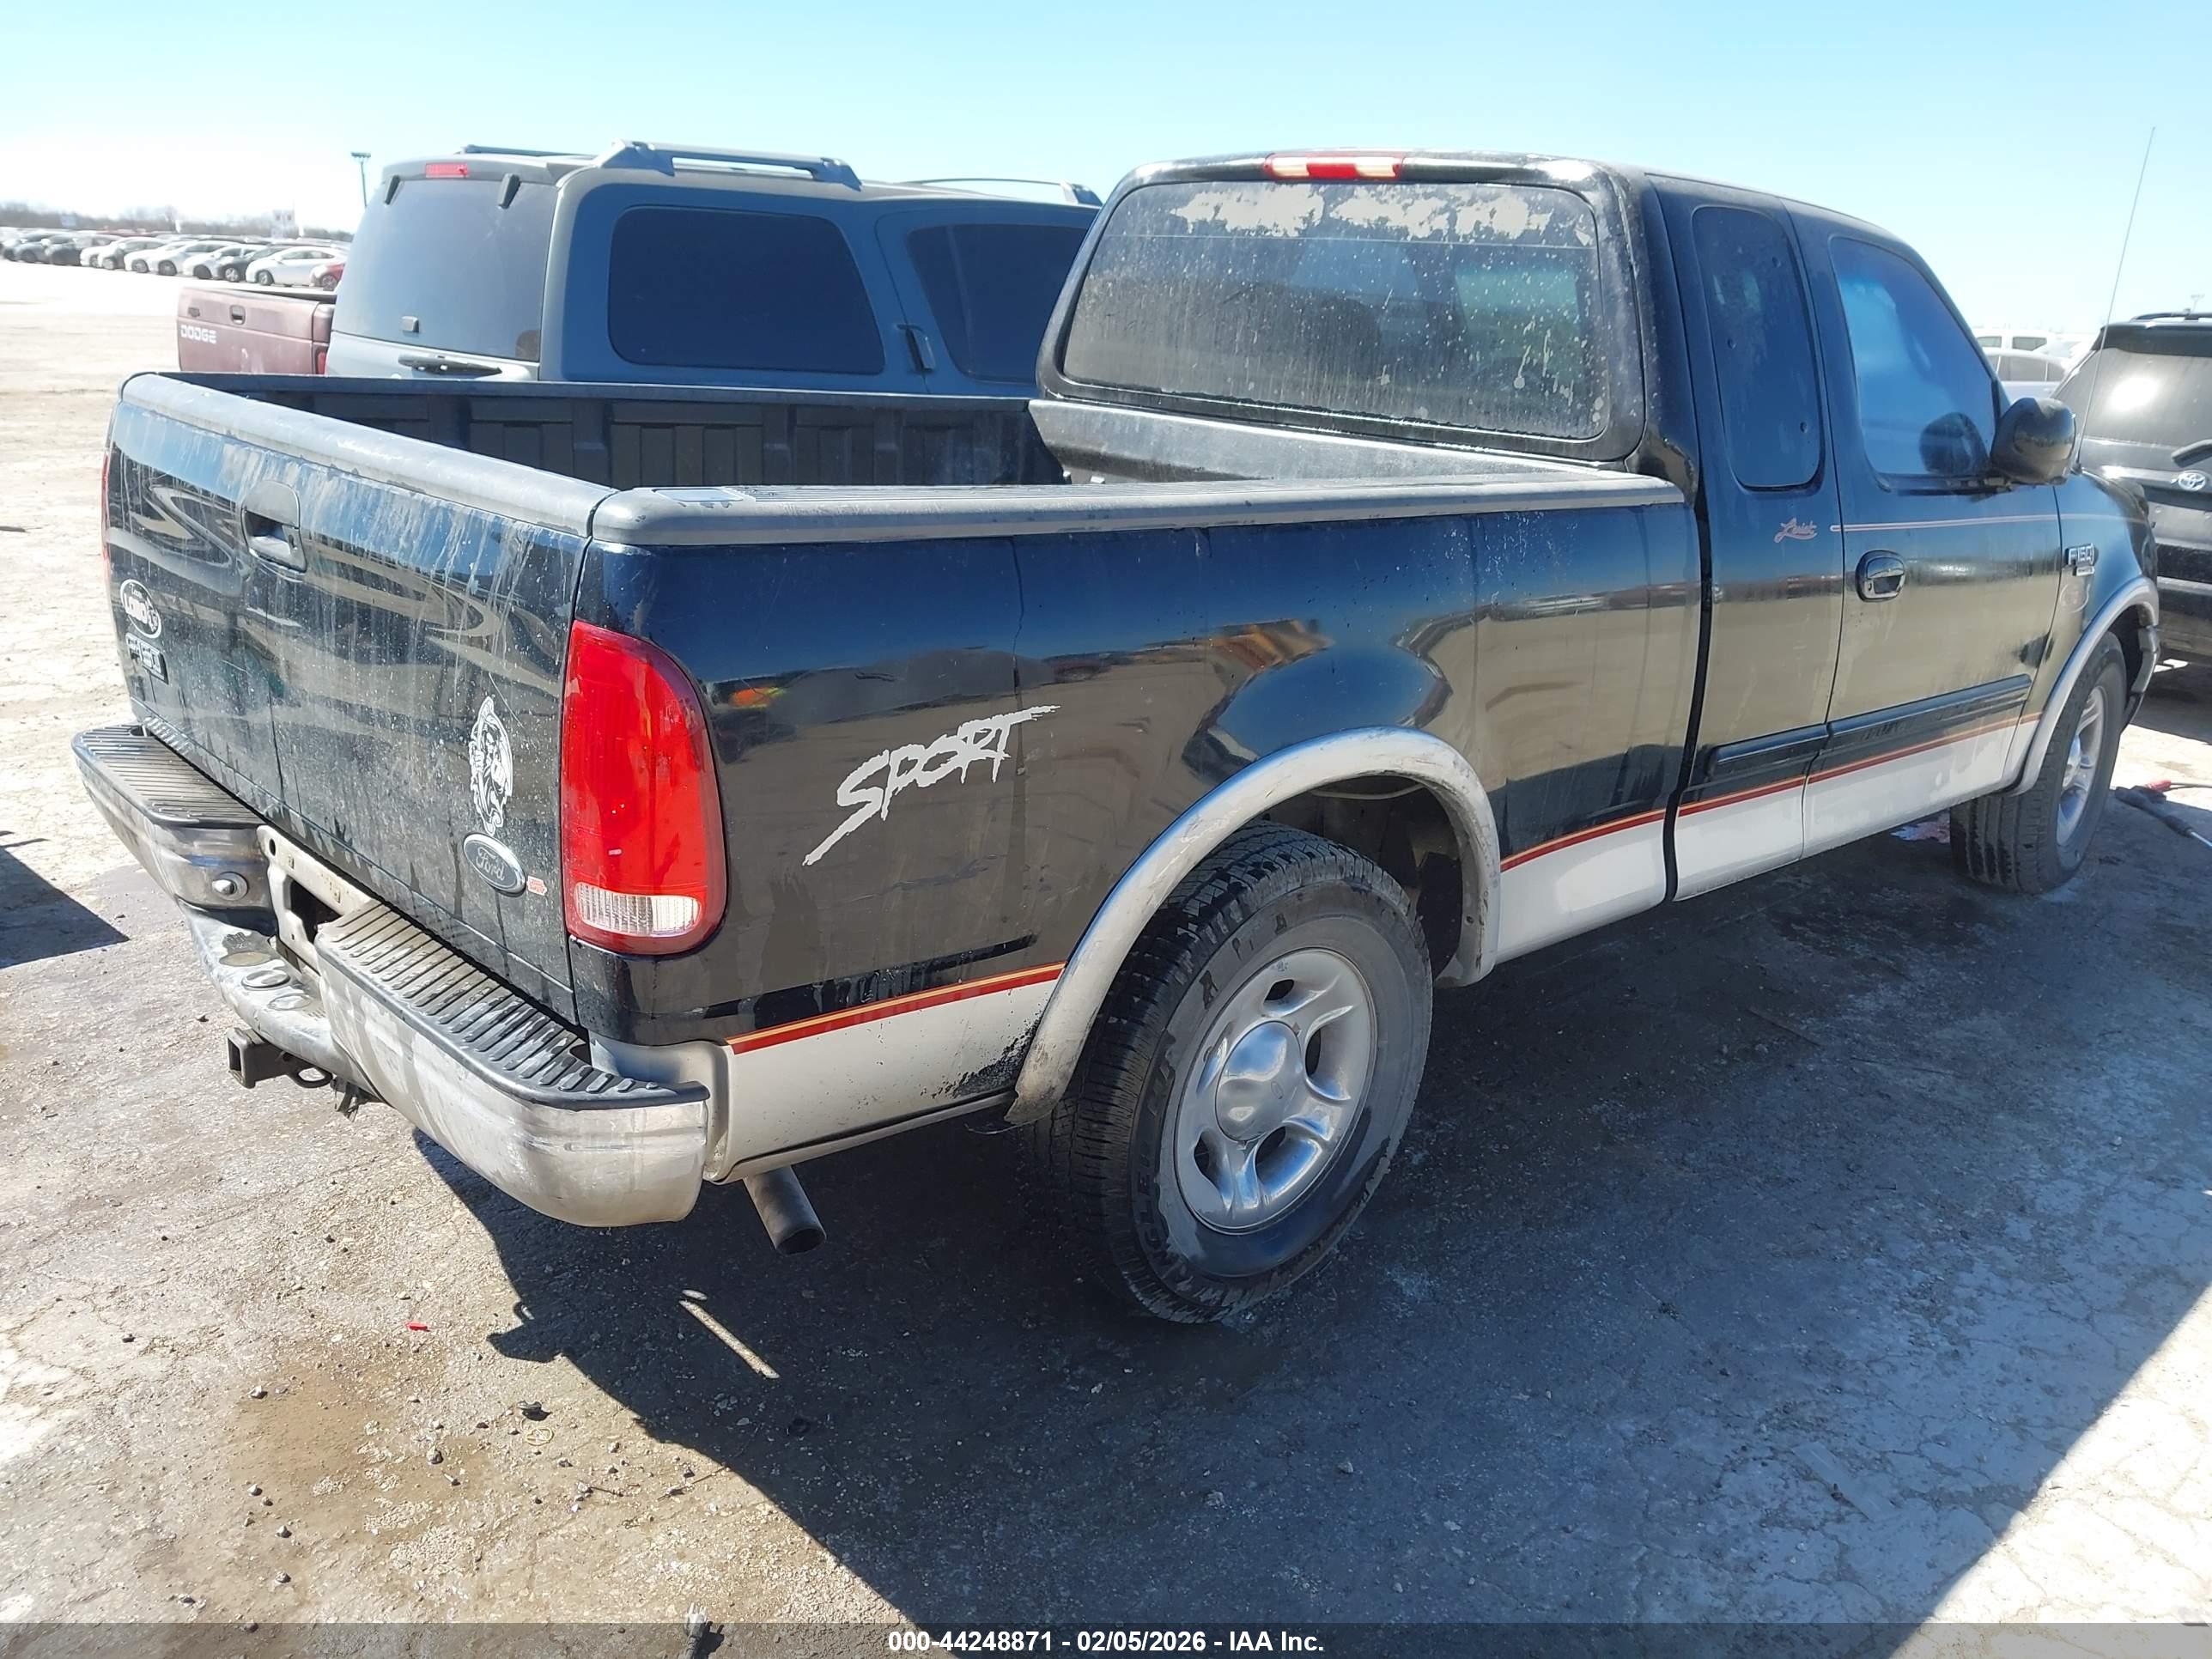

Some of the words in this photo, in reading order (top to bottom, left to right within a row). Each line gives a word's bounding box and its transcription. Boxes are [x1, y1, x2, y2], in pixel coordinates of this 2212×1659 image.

[180, 324, 217, 344] DODGE
[802, 704, 1061, 866] SPORT
[475, 846, 507, 882] Ford
